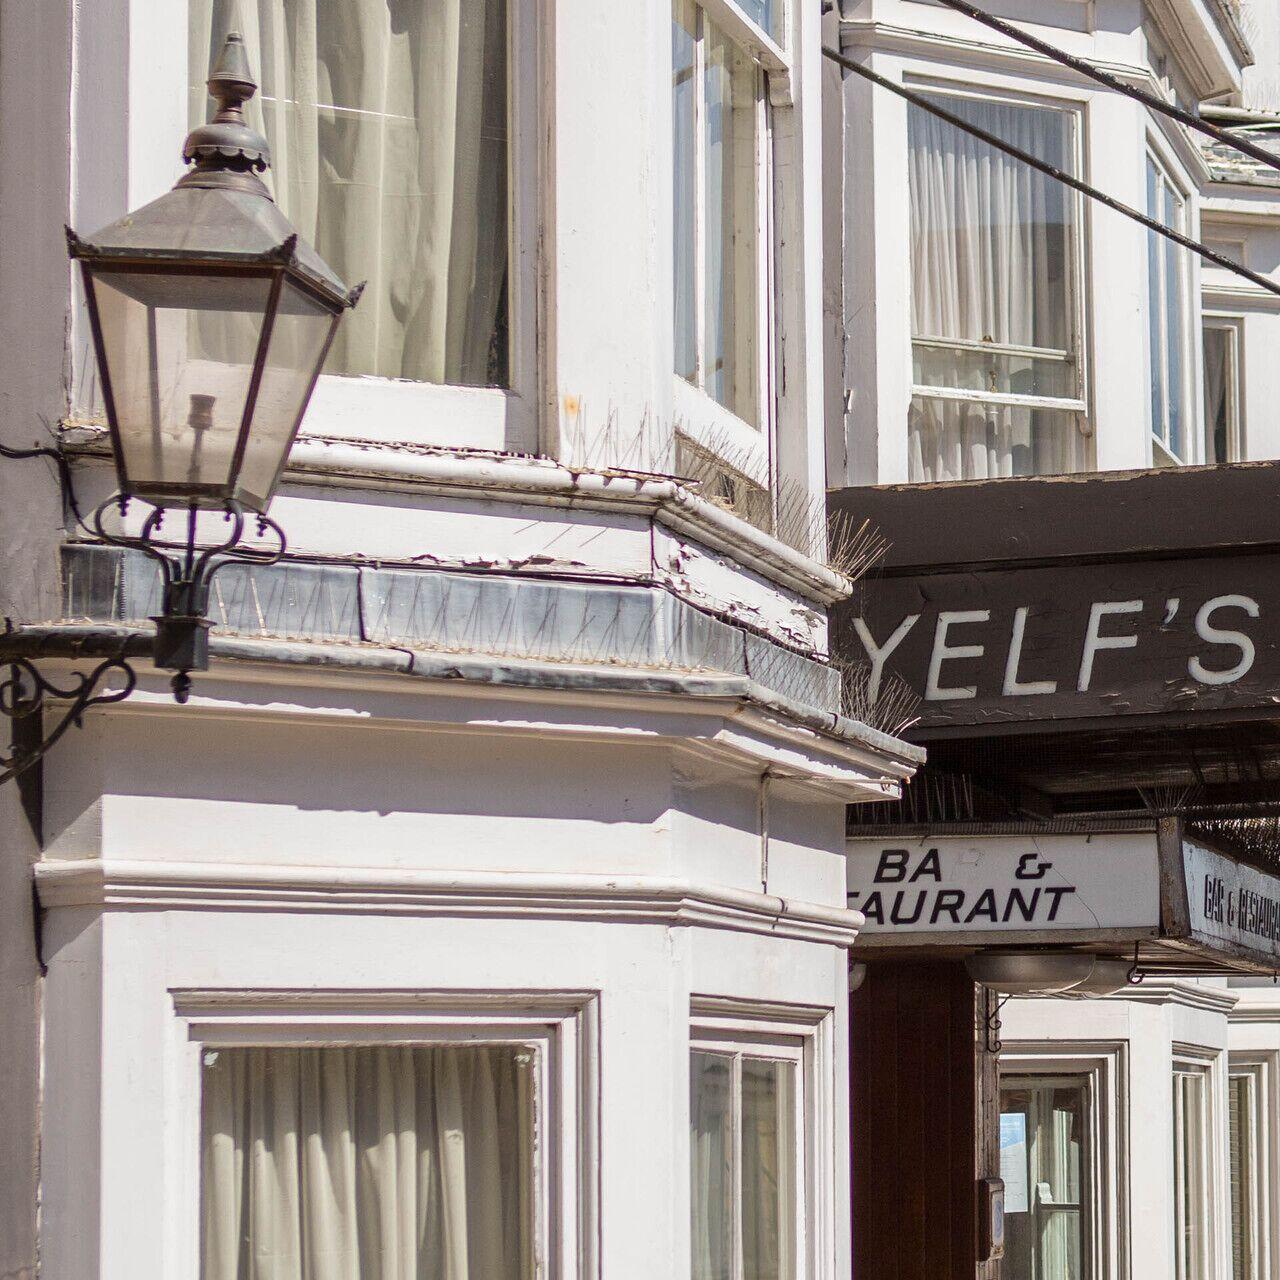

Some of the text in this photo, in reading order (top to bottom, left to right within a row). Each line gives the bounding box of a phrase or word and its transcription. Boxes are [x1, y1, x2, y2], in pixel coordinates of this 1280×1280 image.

[850, 594, 1260, 705] YELF'S
[873, 848, 1053, 883] BA &
[1204, 873, 1224, 923] BAR
[1227, 890, 1236, 927] &
